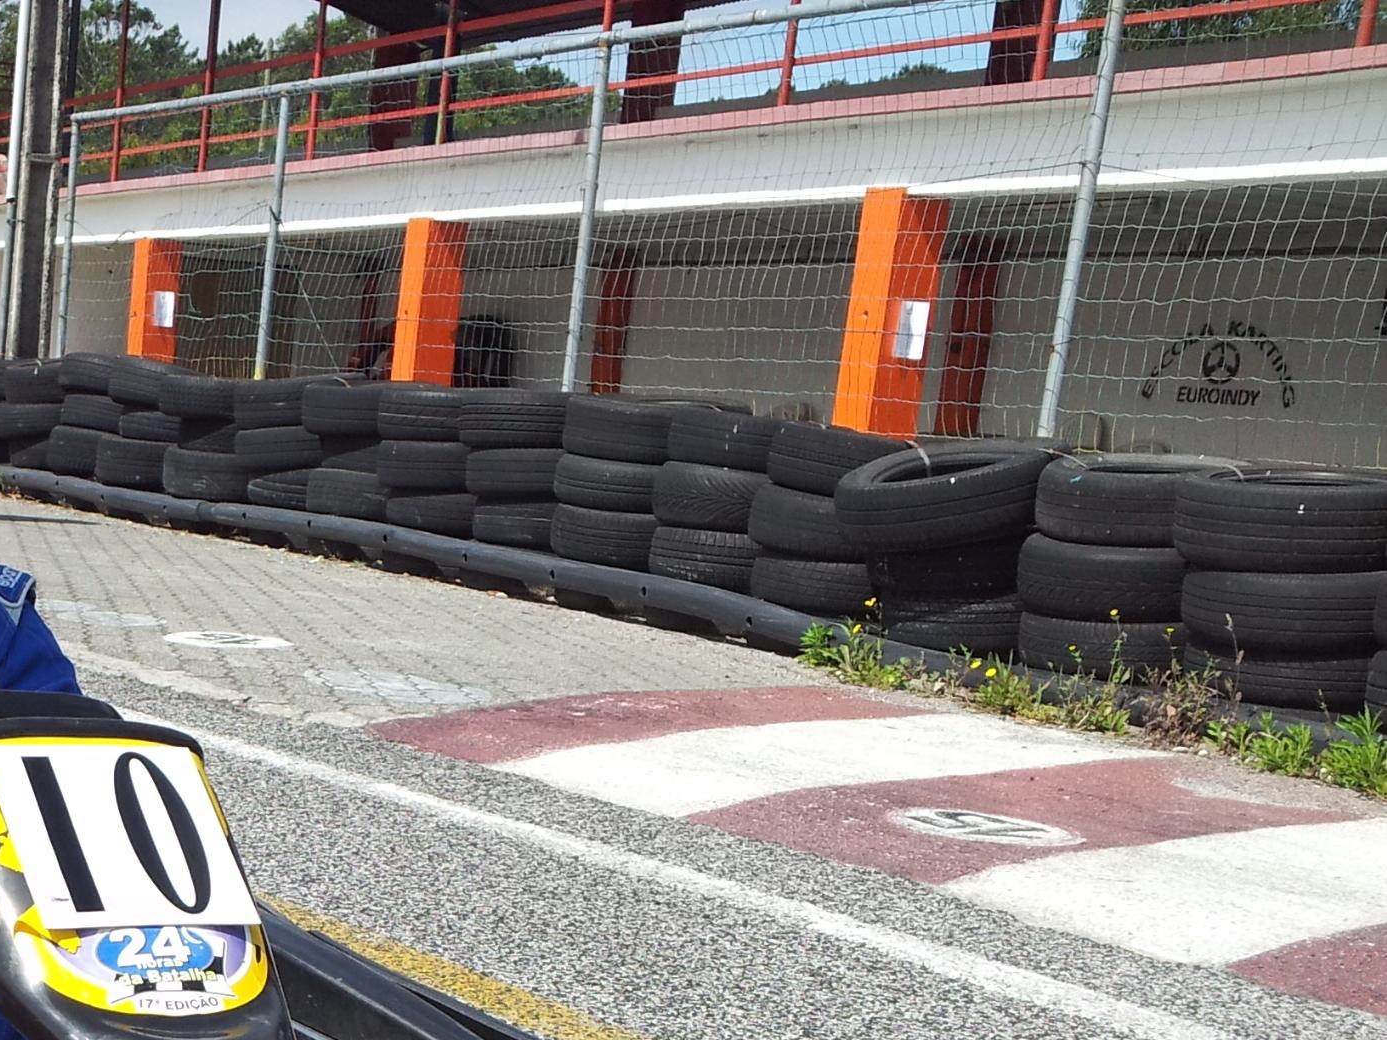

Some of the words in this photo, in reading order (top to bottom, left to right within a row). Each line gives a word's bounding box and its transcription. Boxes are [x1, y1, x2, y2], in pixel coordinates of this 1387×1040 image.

[1141, 323, 1213, 399] ESCOLA
[1227, 320, 1295, 408] KARTING
[1176, 386, 1261, 406] EUROINDY
[21, 751, 211, 915] 10
[110, 926, 191, 968] 24
[117, 972, 143, 986] da
[147, 967, 218, 983] Batalha
[166, 996, 219, 1010] EDIÇÃO
